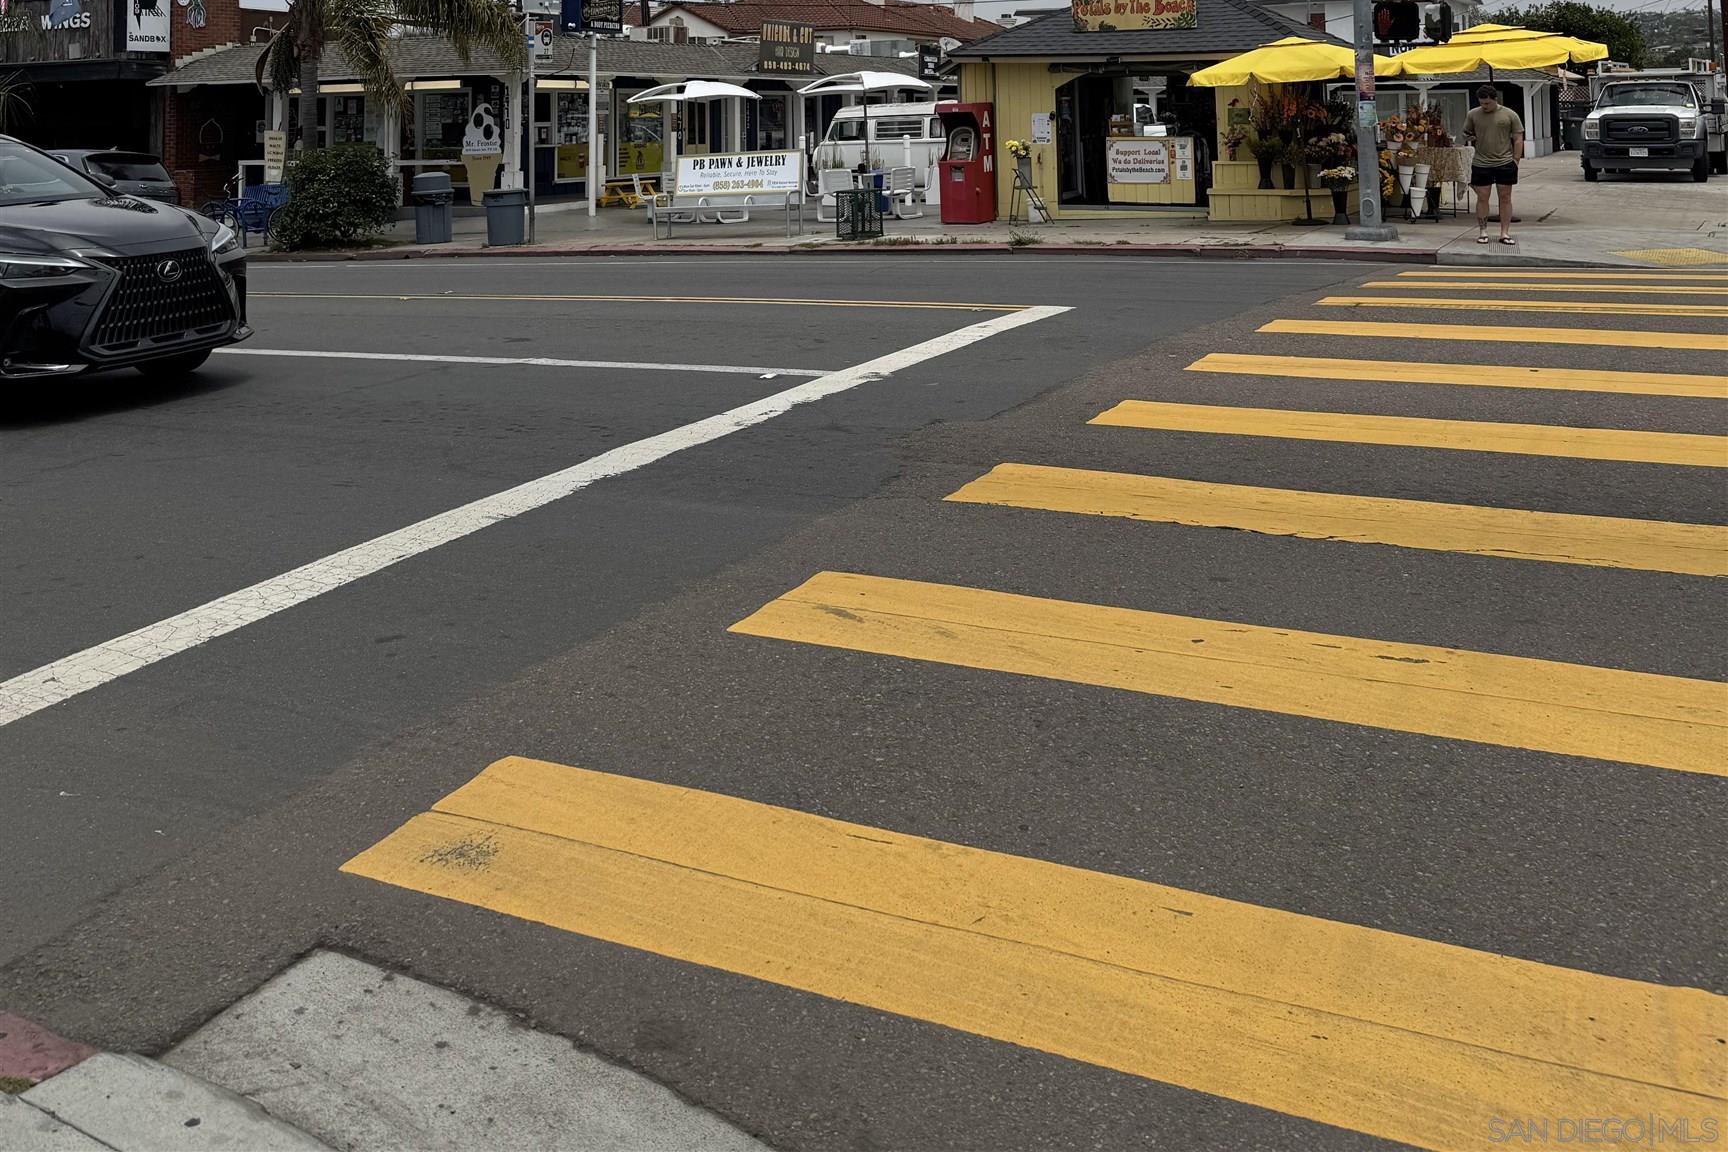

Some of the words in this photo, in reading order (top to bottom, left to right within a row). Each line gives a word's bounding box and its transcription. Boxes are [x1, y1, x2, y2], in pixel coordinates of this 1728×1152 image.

[800, 27, 813, 44] CUT
[1115, 149, 1140, 157] Support
[693, 159, 706, 170] PB
[709, 158, 733, 169] PAWN
[736, 157, 743, 168] &
[746, 154, 787, 169] JEWELRY
[766, 168, 778, 176] Stay
